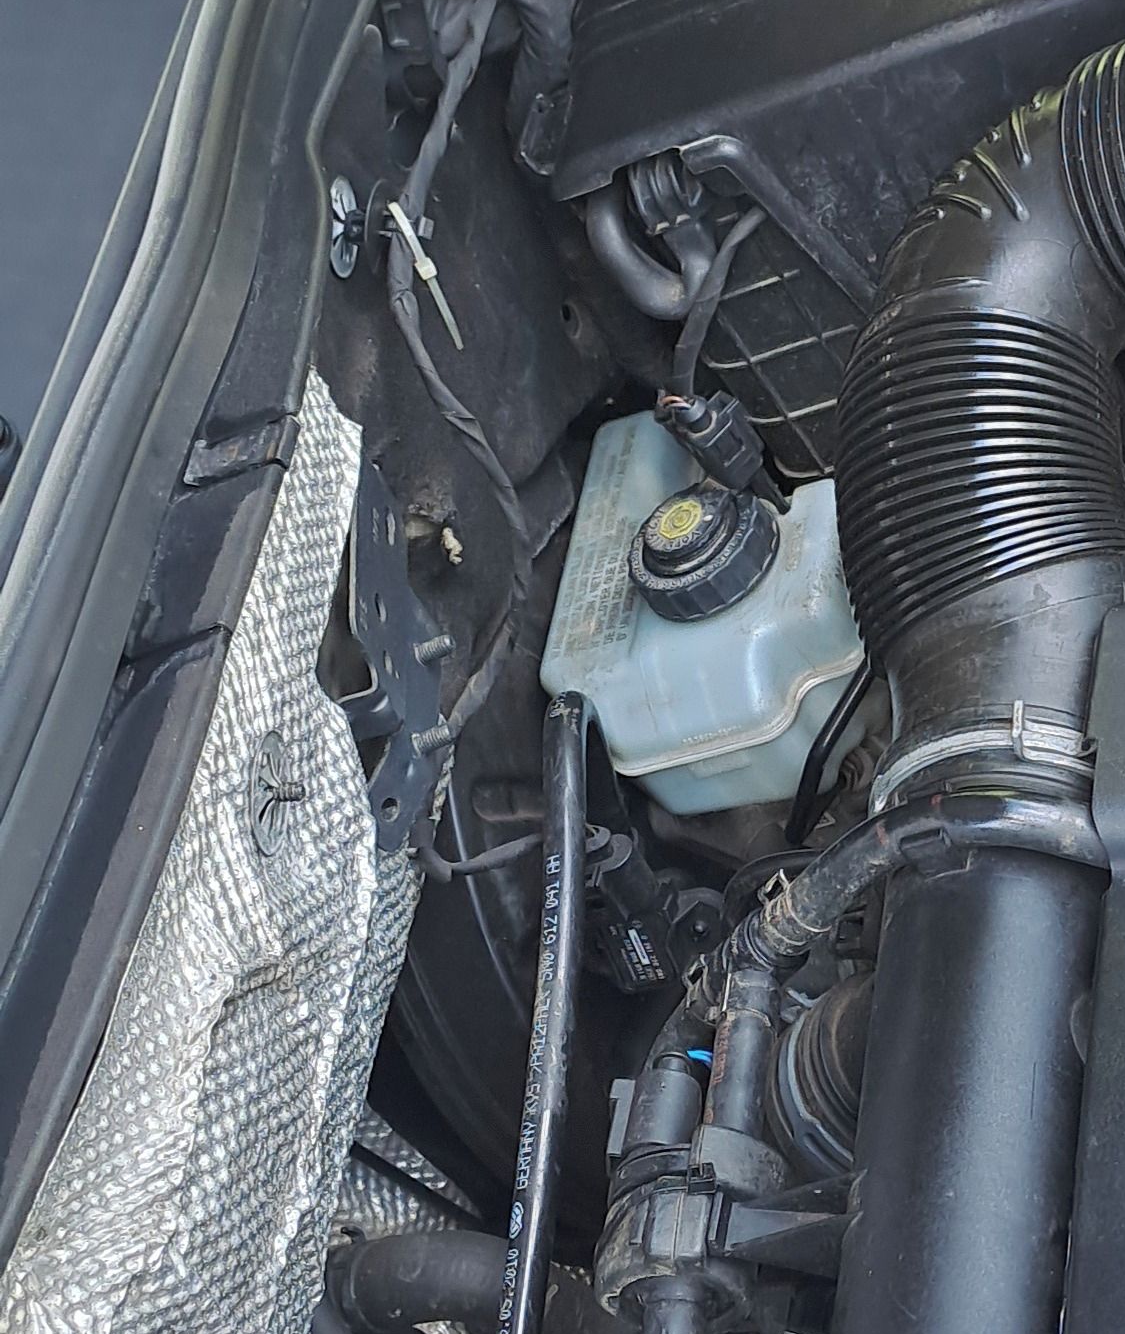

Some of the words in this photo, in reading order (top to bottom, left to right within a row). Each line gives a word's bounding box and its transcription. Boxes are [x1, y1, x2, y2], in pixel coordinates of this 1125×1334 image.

[546, 854, 562, 874] AH
[543, 914, 559, 945] 612
[515, 1121, 536, 1190] GERMANY
